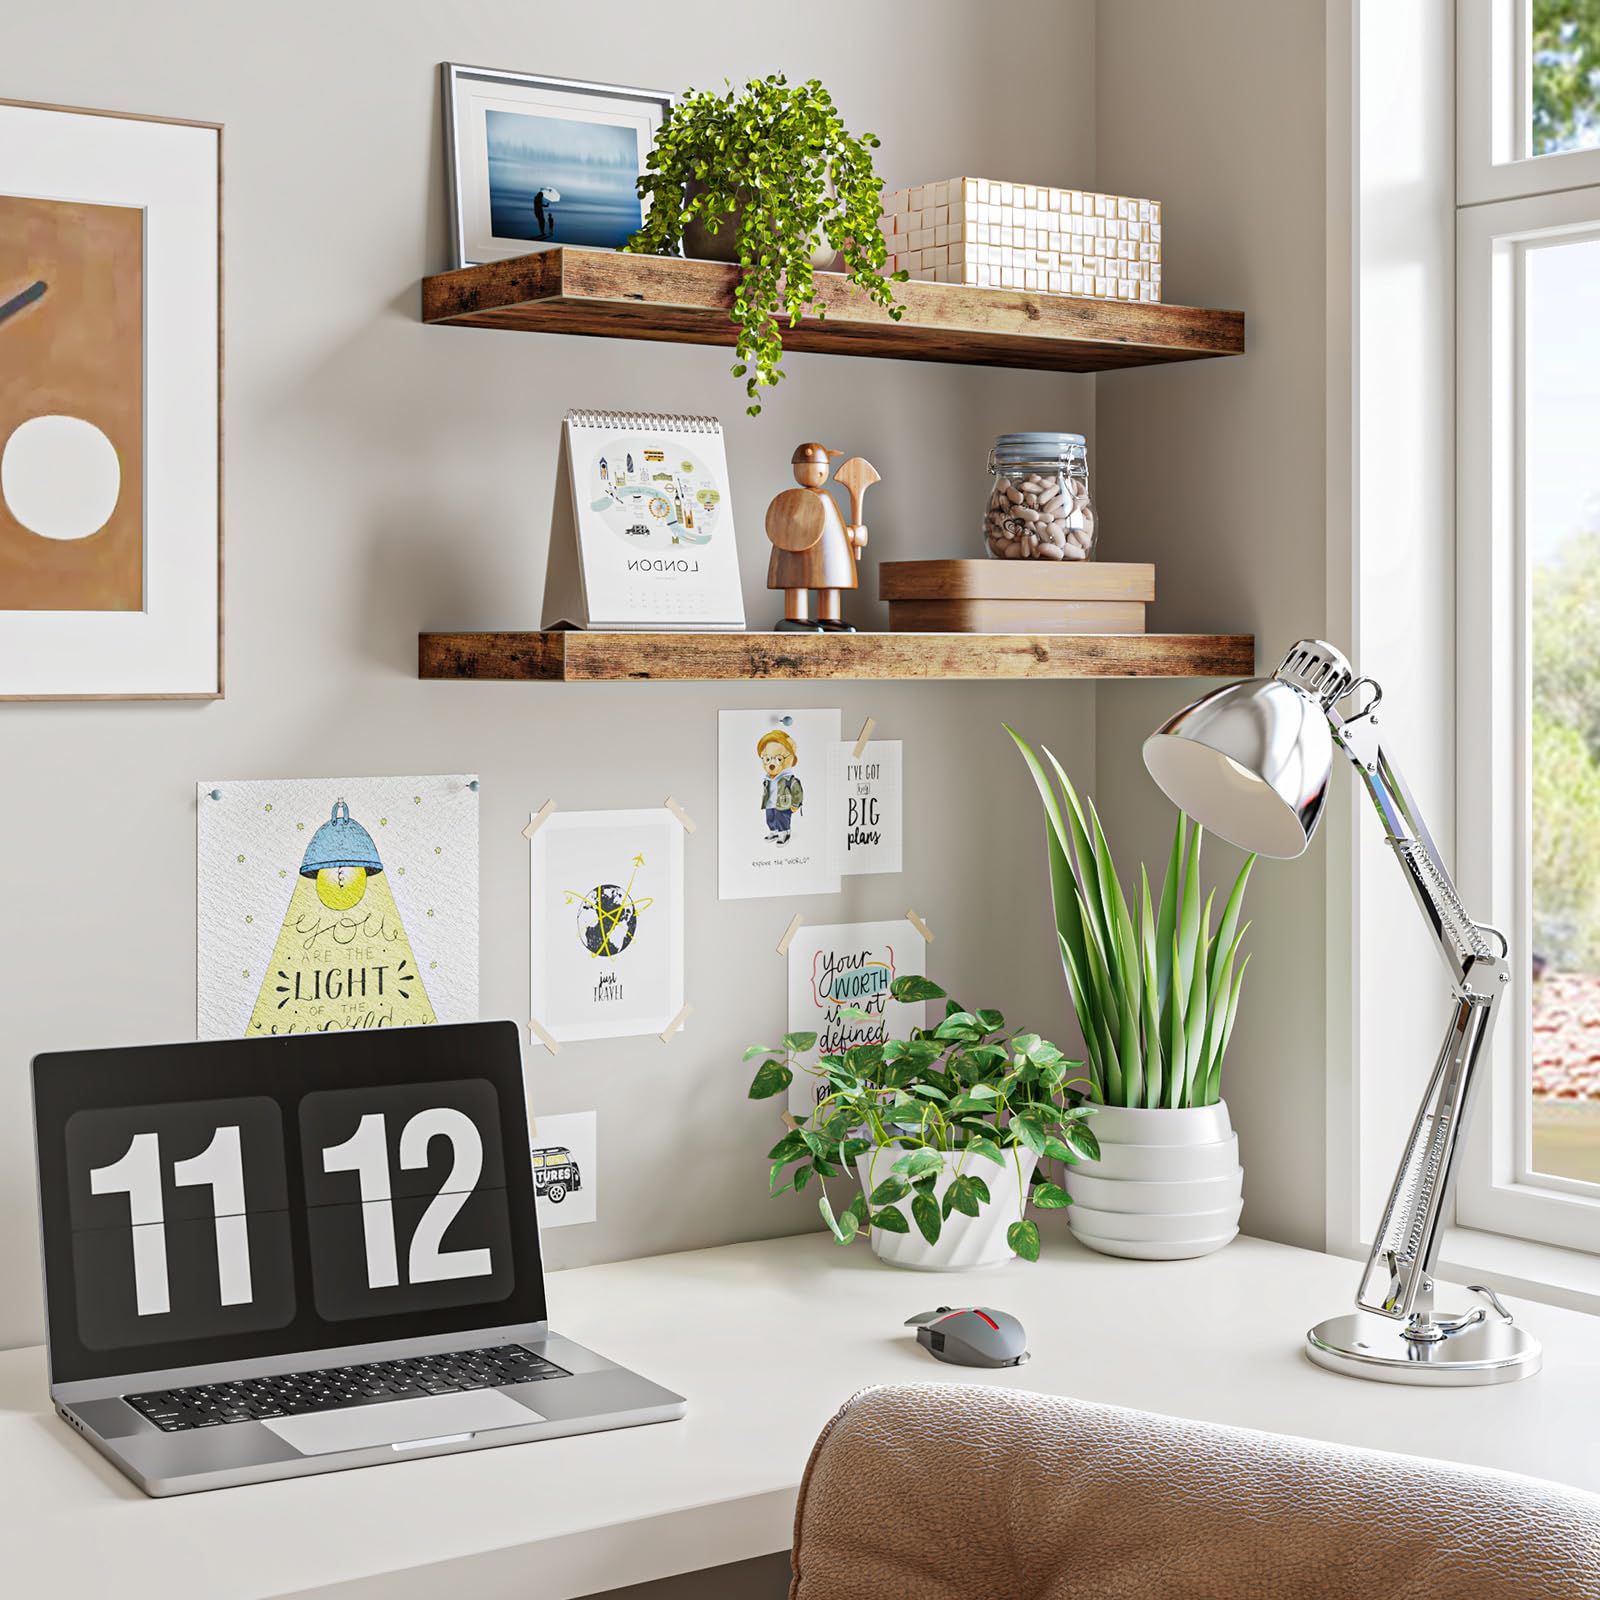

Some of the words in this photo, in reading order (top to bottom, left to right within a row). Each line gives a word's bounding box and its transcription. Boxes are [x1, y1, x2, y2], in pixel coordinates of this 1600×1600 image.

[847, 765, 862, 781] I'VE
[865, 764, 880, 780] GOT
[848, 797, 880, 826] BIG
[847, 826, 881, 851] plans
[301, 949, 332, 963] ARE
[346, 947, 375, 961] THE
[294, 965, 389, 1001] LIGHT
[834, 968, 888, 999] WORTH
[309, 1005, 325, 1017] OF
[341, 1002, 366, 1014] THE
[819, 1019, 889, 1056] defined
[89, 1125, 253, 1317] 11
[322, 1106, 492, 1289] 12
